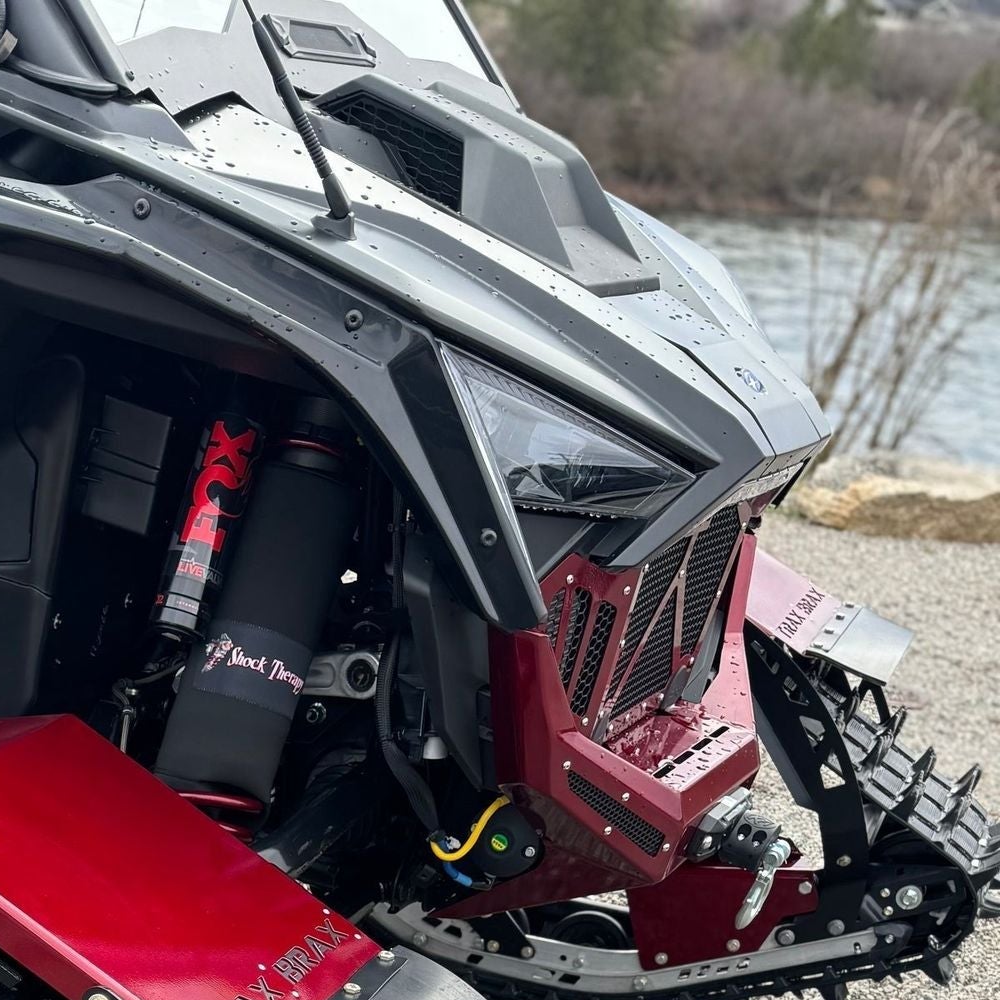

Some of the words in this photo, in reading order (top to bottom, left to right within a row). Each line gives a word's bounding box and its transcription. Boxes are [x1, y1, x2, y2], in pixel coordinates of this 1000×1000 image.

[180, 421, 257, 553] FOX
[776, 609, 806, 639] TRAX
[796, 587, 825, 615] BRAX
[227, 646, 269, 674] Shock
[268, 659, 304, 695] Therapy
[271, 918, 349, 985] BRAX
